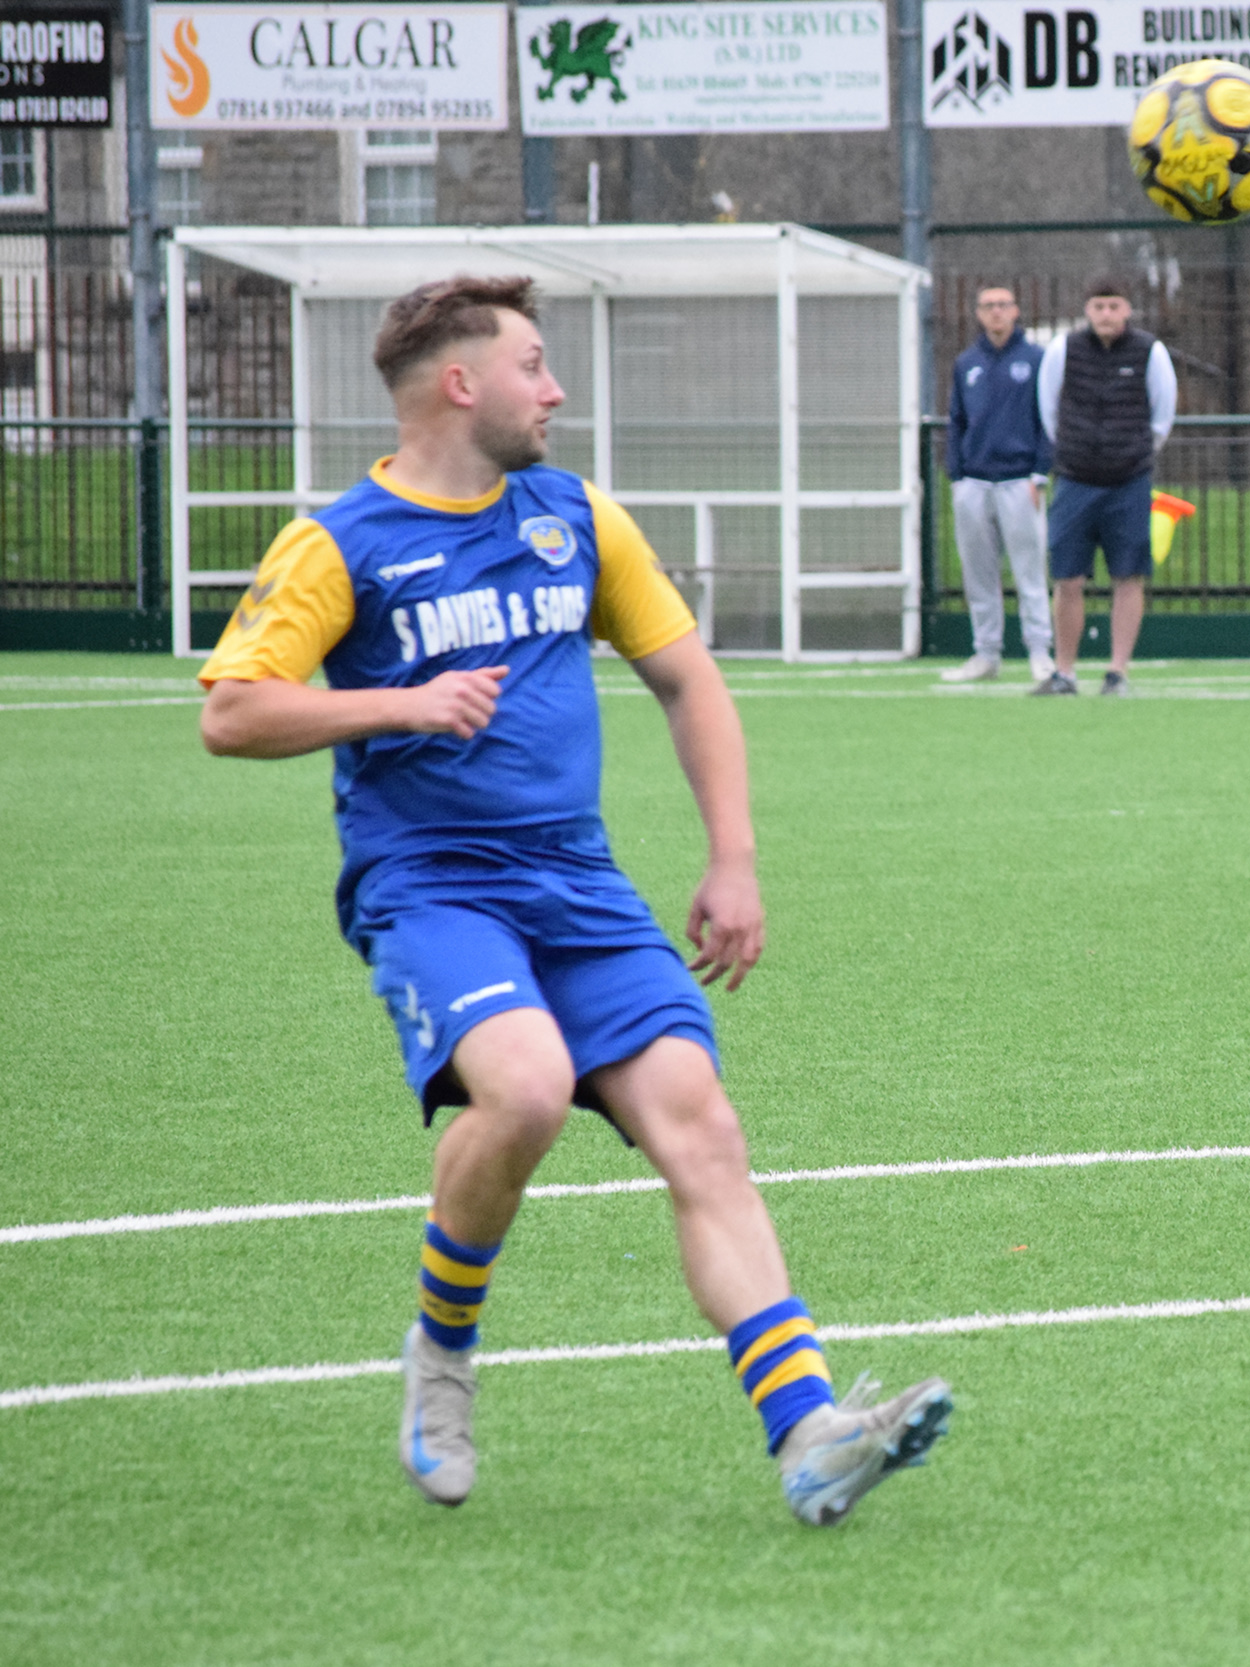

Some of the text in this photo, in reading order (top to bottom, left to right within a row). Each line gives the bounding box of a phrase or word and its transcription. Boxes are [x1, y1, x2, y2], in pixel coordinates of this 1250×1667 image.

[1, 21, 105, 64] ROOFING
[249, 18, 458, 69] CALGAR
[637, 9, 880, 40] KING SITE SERVICES
[1024, 11, 1100, 89] DB
[392, 608, 416, 662] S
[416, 587, 506, 657] DAVIES
[508, 592, 530, 637] &
